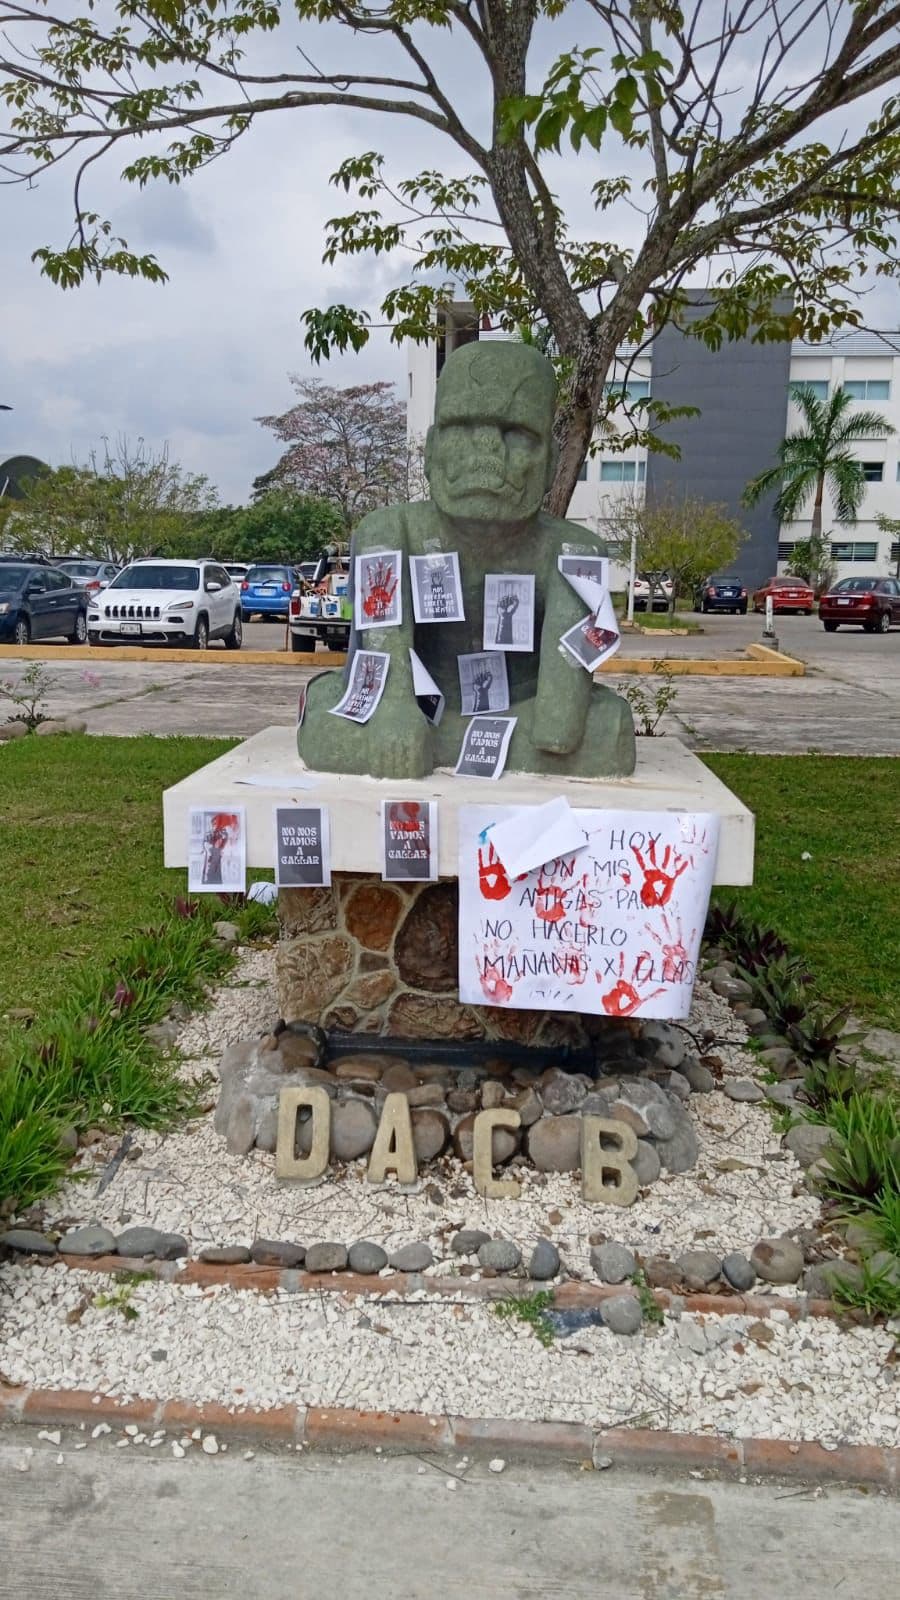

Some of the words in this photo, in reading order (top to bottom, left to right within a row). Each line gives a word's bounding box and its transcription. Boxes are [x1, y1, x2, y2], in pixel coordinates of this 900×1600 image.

[479, 747, 486, 755] A
[281, 826, 296, 836] NO
[297, 826, 317, 837] NOS
[390, 831, 425, 840] VAMOS
[282, 837, 318, 847] VAMOS
[403, 840, 412, 850] A
[609, 829, 663, 855] HOY
[296, 846, 304, 856] A
[388, 849, 428, 859] CALLAR
[280, 855, 320, 865] CALLAR
[594, 858, 632, 881] MIS
[484, 918, 513, 941] NO
[532, 918, 628, 947] HACERLO
[603, 956, 619, 977] X
[635, 955, 695, 985] ELLAS
